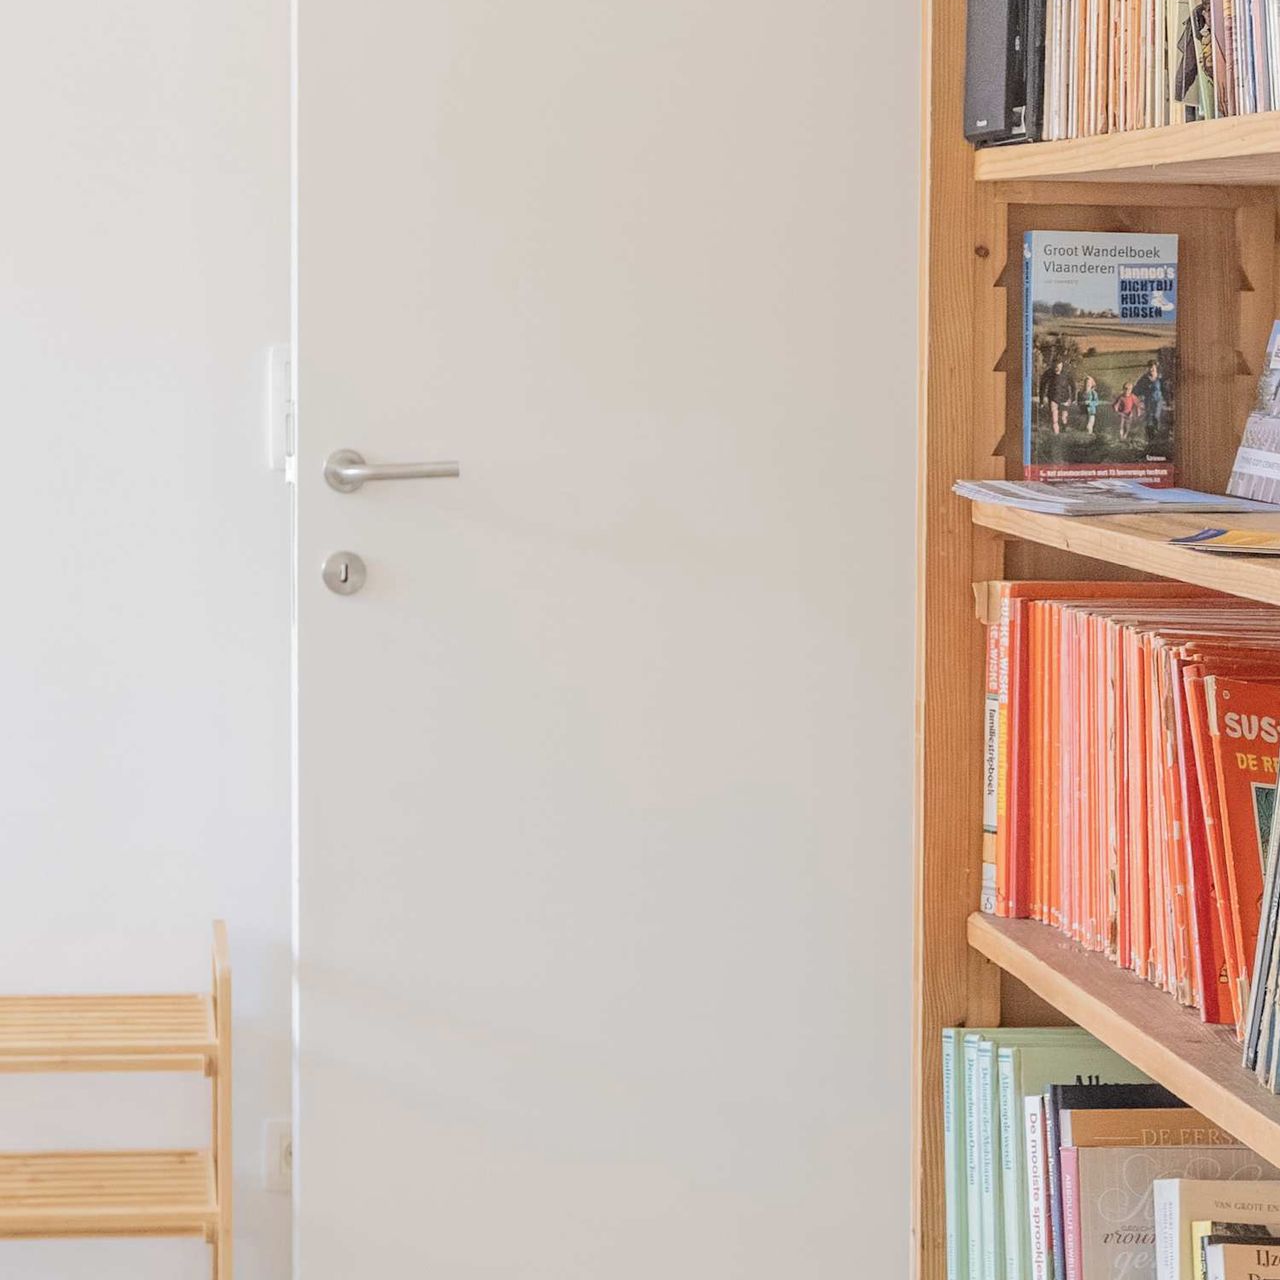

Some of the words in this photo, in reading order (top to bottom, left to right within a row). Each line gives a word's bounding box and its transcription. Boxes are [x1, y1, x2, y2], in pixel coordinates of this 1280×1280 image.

[1043, 244, 1079, 257] Groot
[1081, 245, 1161, 259] Wandelboek
[1043, 261, 1115, 274] Vlaanderen
[1120, 279, 1173, 293] DICHTBIJ
[1121, 293, 1149, 305] HUIS
[1121, 307, 1163, 319] GIDSEN
[989, 648, 999, 690] WISKE
[1000, 657, 1009, 704] WISKE
[1236, 753, 1258, 771] DE
[1030, 1113, 1038, 1134] De
[1141, 1128, 1172, 1146] DE
[1031, 1140, 1040, 1202] mooiste
[1214, 1200, 1232, 1210] VAN
[1267, 1204, 1279, 1213] EN
[1032, 1206, 1043, 1280] sprookjes
